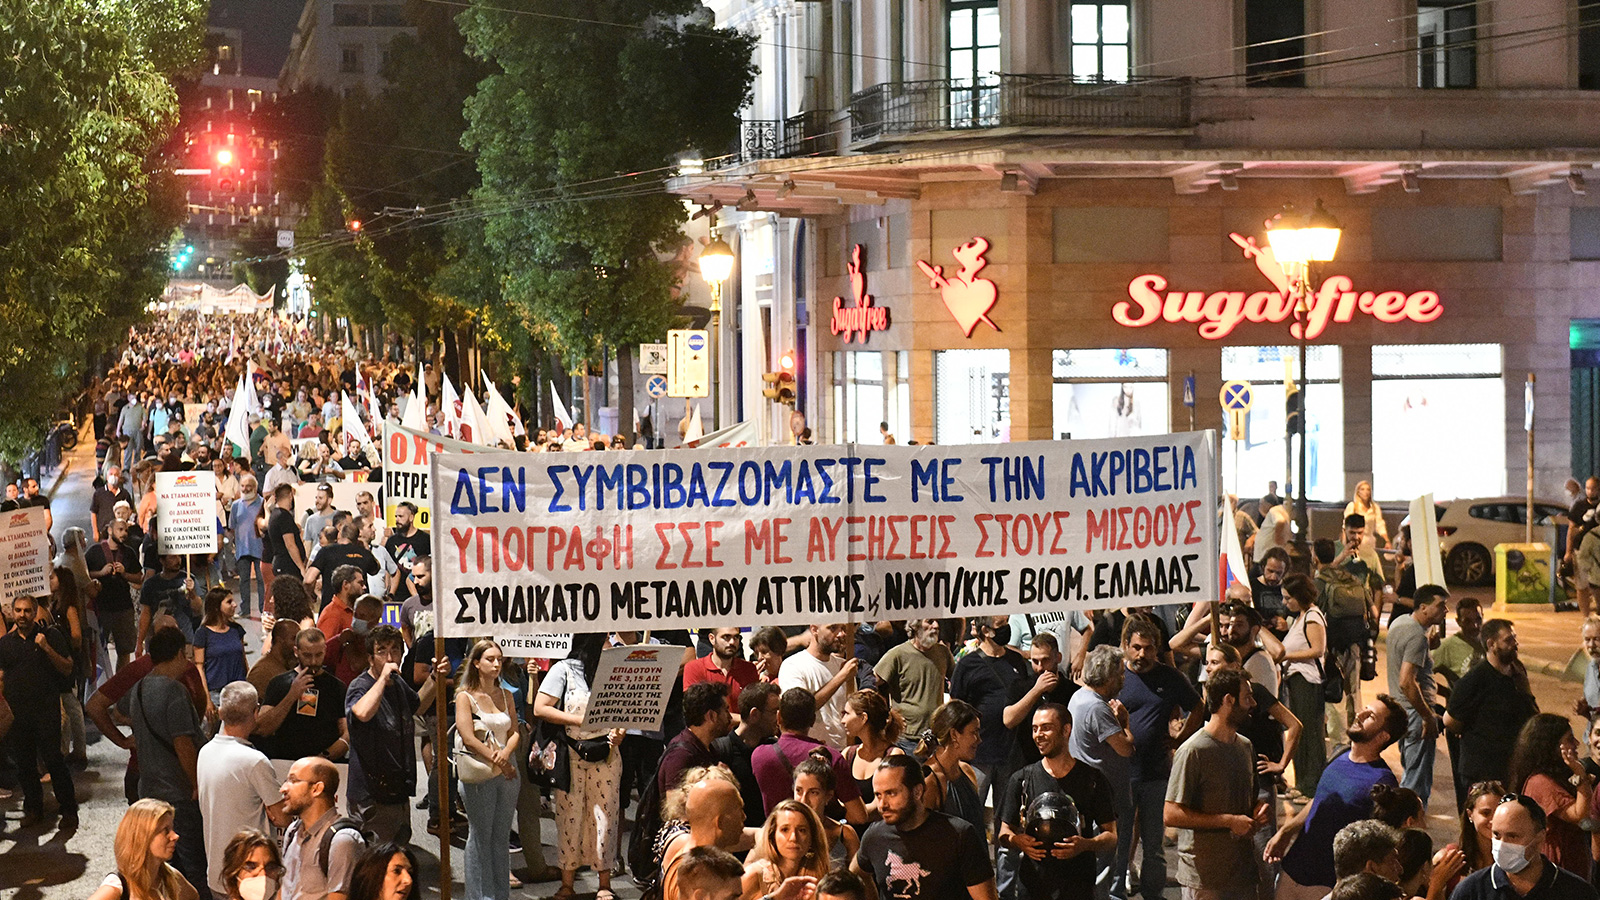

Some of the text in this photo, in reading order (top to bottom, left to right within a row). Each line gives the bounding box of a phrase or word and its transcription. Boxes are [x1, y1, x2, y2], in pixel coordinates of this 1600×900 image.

[830, 294, 886, 344] Sugarfree
[450, 445, 1197, 516] ΔΕΝ ΣΥΜΒΙΒΑΖΟΜΑΣΤΕ ΜΕ ΤΗΝ ΑΚΡΙΒΕΙΑ
[450, 500, 1202, 574] ΥΠΟΓΡΑΦΗ ΣΣΕ ΜΕ ΑΥΞΗΣΕΙΣ ΣΤΟΥΣ ΜΙΣΘΟΥΣ
[454, 582, 600, 624] ΣΥΝΔΙΚΑΤΟ
[610, 577, 748, 620] ΜΕΤΑΛΛΟΥ
[756, 574, 865, 616] ΑΤΤΙΚΗΣ
[886, 566, 1010, 614] ΝΑΥΠ/ΚΗΣ
[1019, 565, 1088, 604] ΒΙΟΜ.
[1094, 554, 1200, 600] ΕΛΛΑΔΑΣ
[501, 639, 567, 649] ΟΥΤΕ ΕΝΑ ΕΥΡΩ
[589, 716, 610, 724] ΟΥΤΕ
